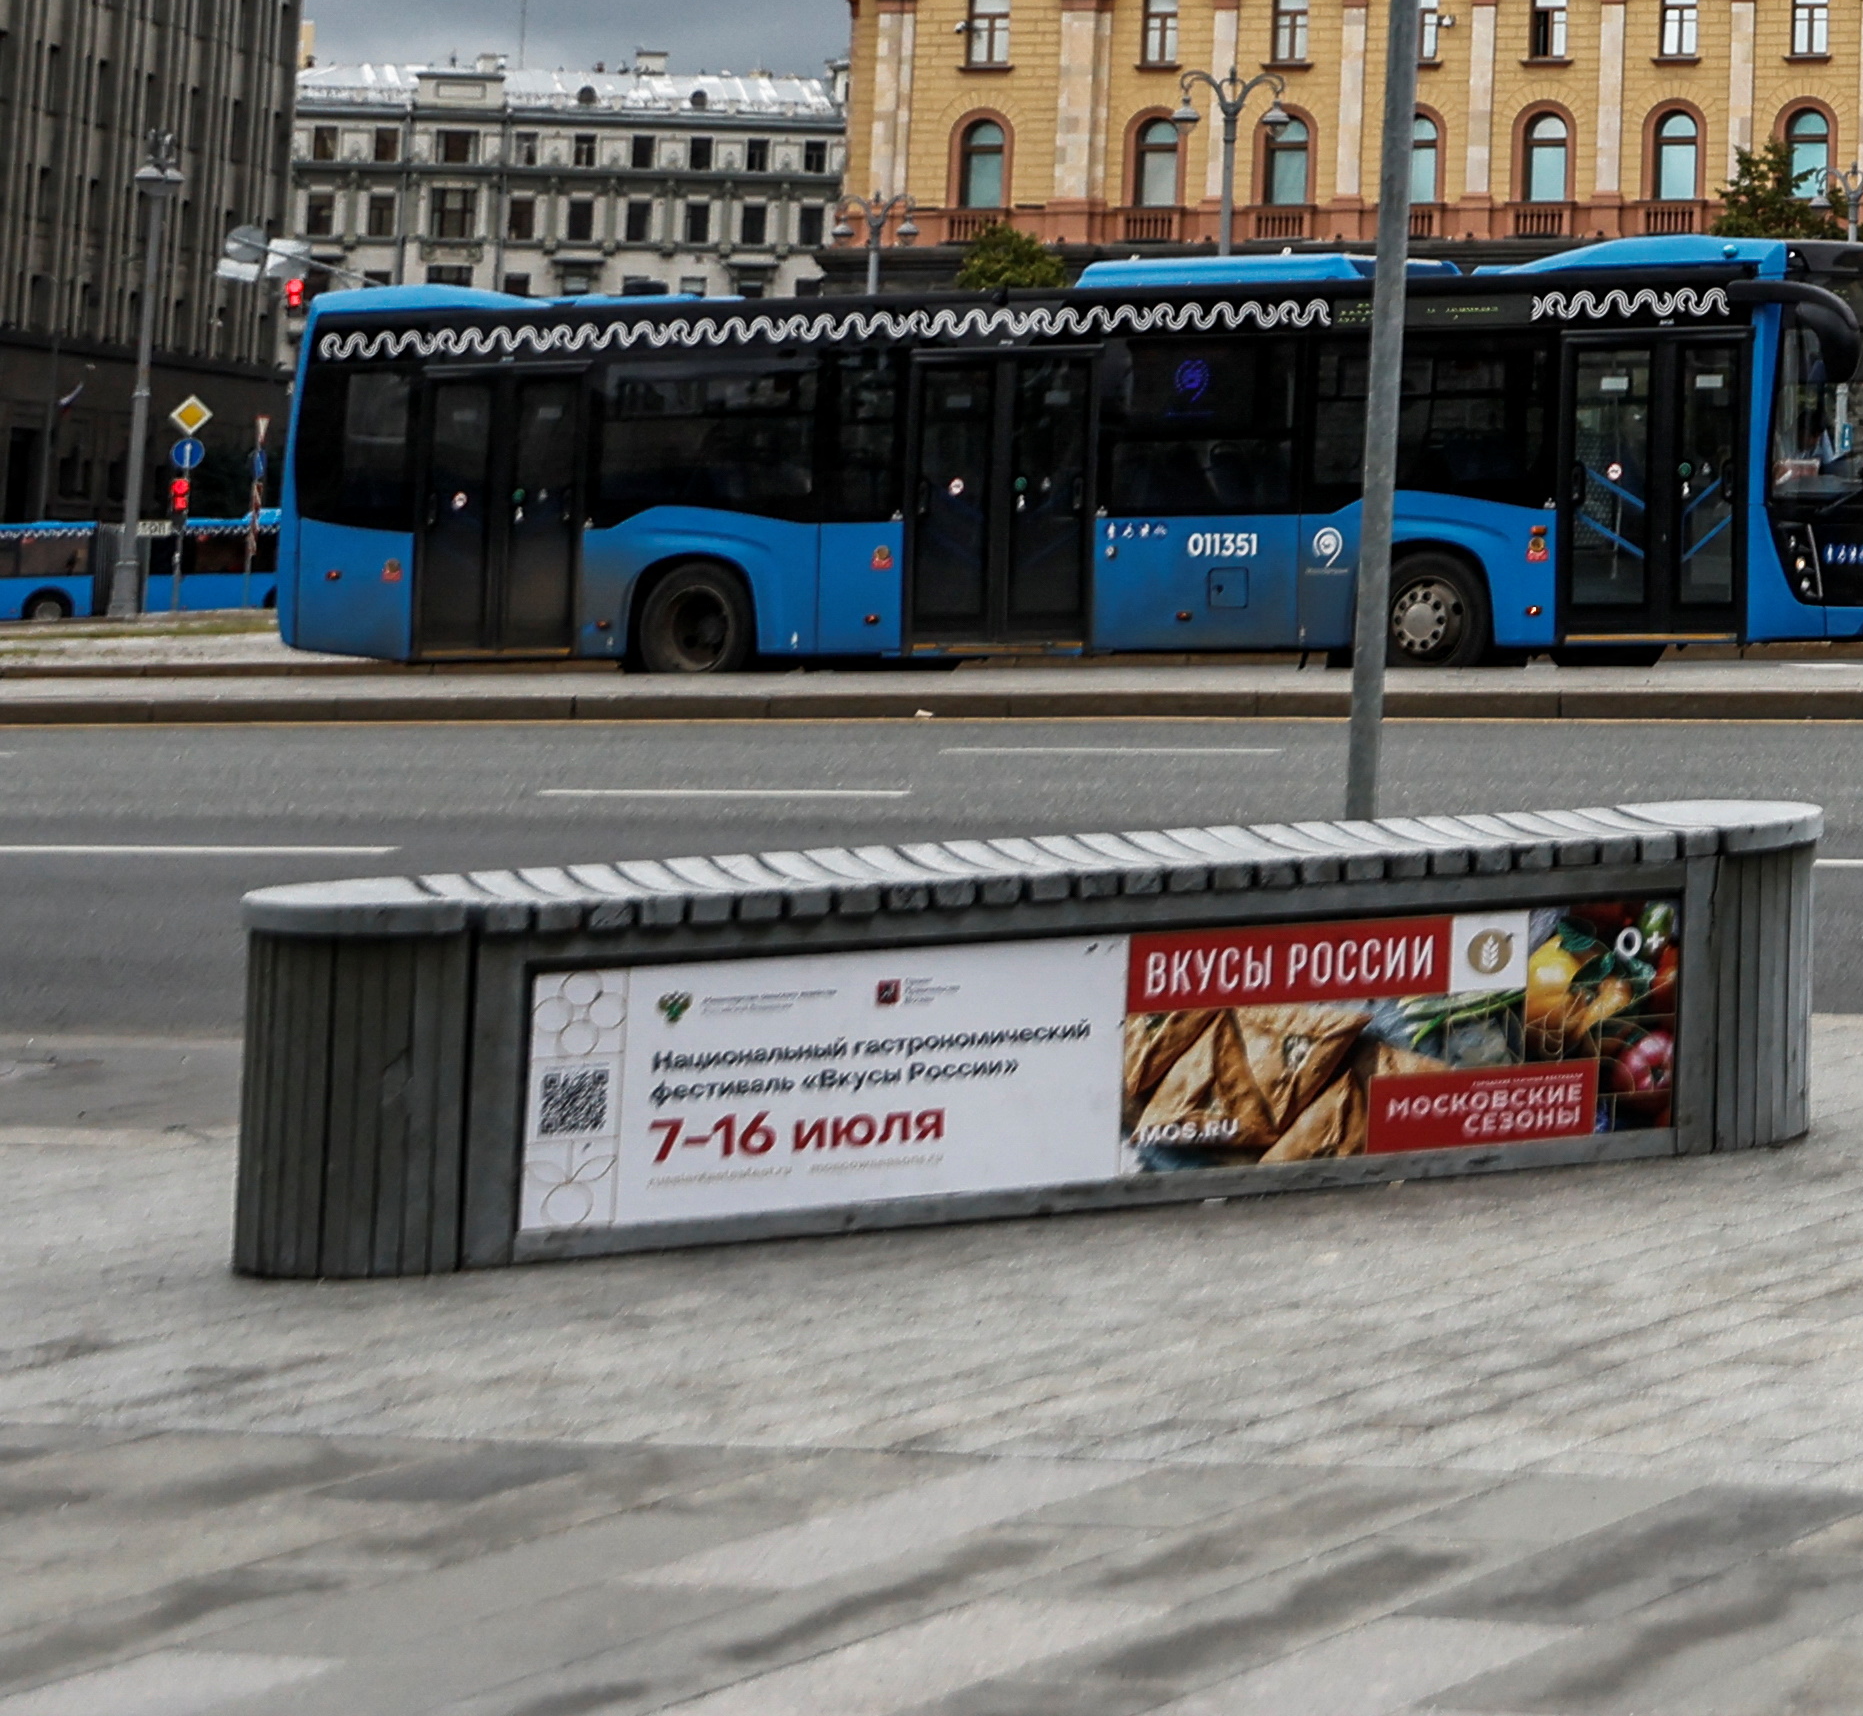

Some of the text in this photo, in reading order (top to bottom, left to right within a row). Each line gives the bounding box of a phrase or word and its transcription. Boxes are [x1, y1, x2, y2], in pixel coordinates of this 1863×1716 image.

[1187, 533, 1258, 557] 011351
[1616, 926, 1666, 960] 0+
[1144, 934, 1434, 998] ВКУСЫ РОССИИ
[651, 1018, 1092, 1075] Национальный гастрономический
[648, 1058, 1020, 1109] фестиваль «Вкусы России»
[1386, 1083, 1583, 1121] МОСКОВСКИЕ
[792, 1107, 946, 1152] июля
[1138, 1118, 1239, 1144] MOS.RU
[1462, 1106, 1582, 1135] СЕЗОНЫ
